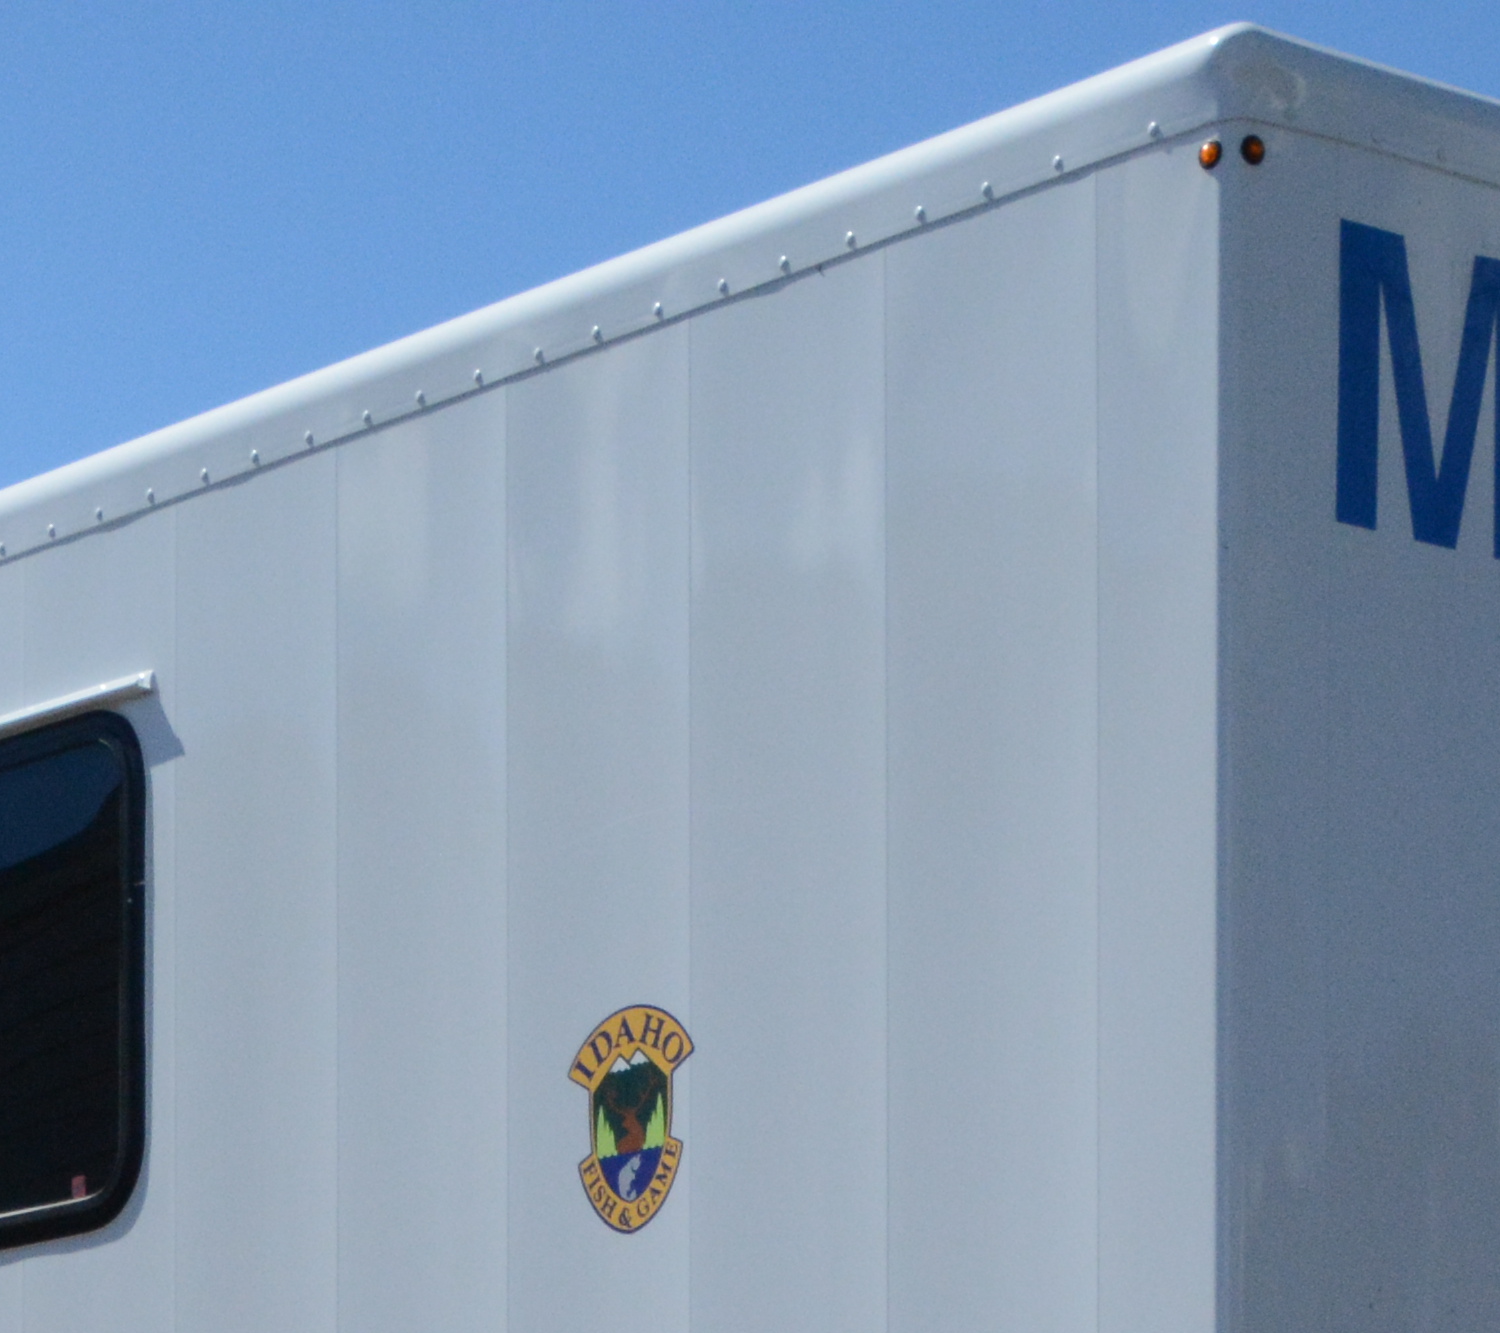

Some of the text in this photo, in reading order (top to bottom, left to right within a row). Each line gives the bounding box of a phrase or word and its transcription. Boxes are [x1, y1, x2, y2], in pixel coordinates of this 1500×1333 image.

[574, 1013, 685, 1082] IDAHO
[583, 1142, 679, 1229] FISH & GAME
